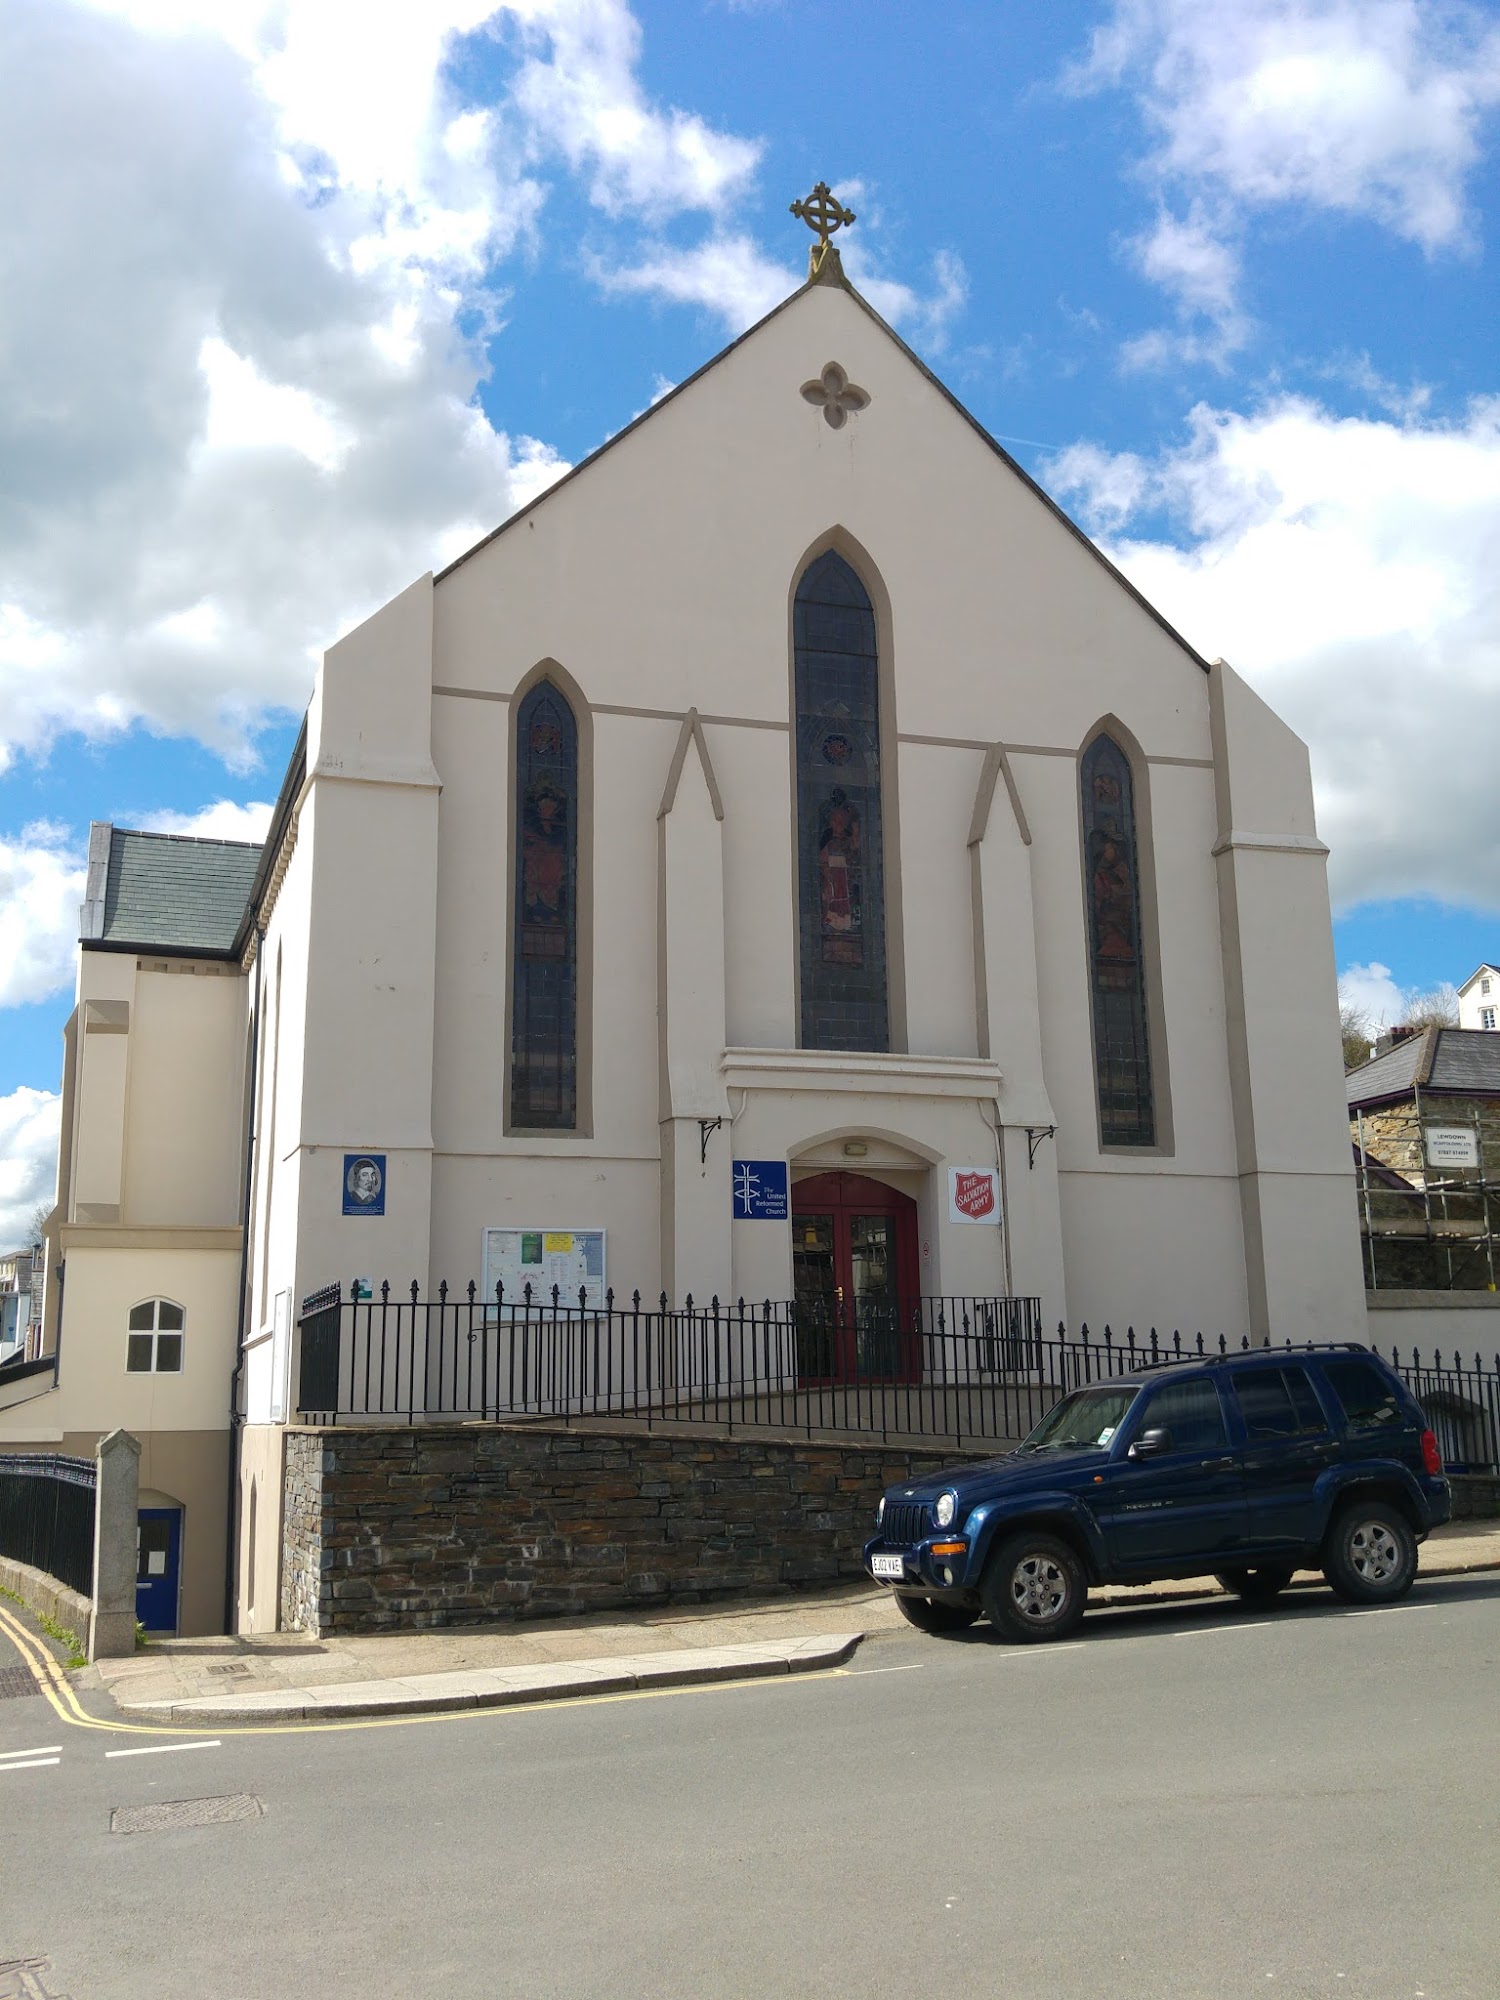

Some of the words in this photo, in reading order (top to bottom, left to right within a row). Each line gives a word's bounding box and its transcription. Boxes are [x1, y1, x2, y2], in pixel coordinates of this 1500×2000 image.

[962, 1177, 977, 1190] THE
[958, 1180, 989, 1206] SALVATION
[970, 1192, 989, 1213] ARMY
[873, 1558, 887, 1571] EJ02
